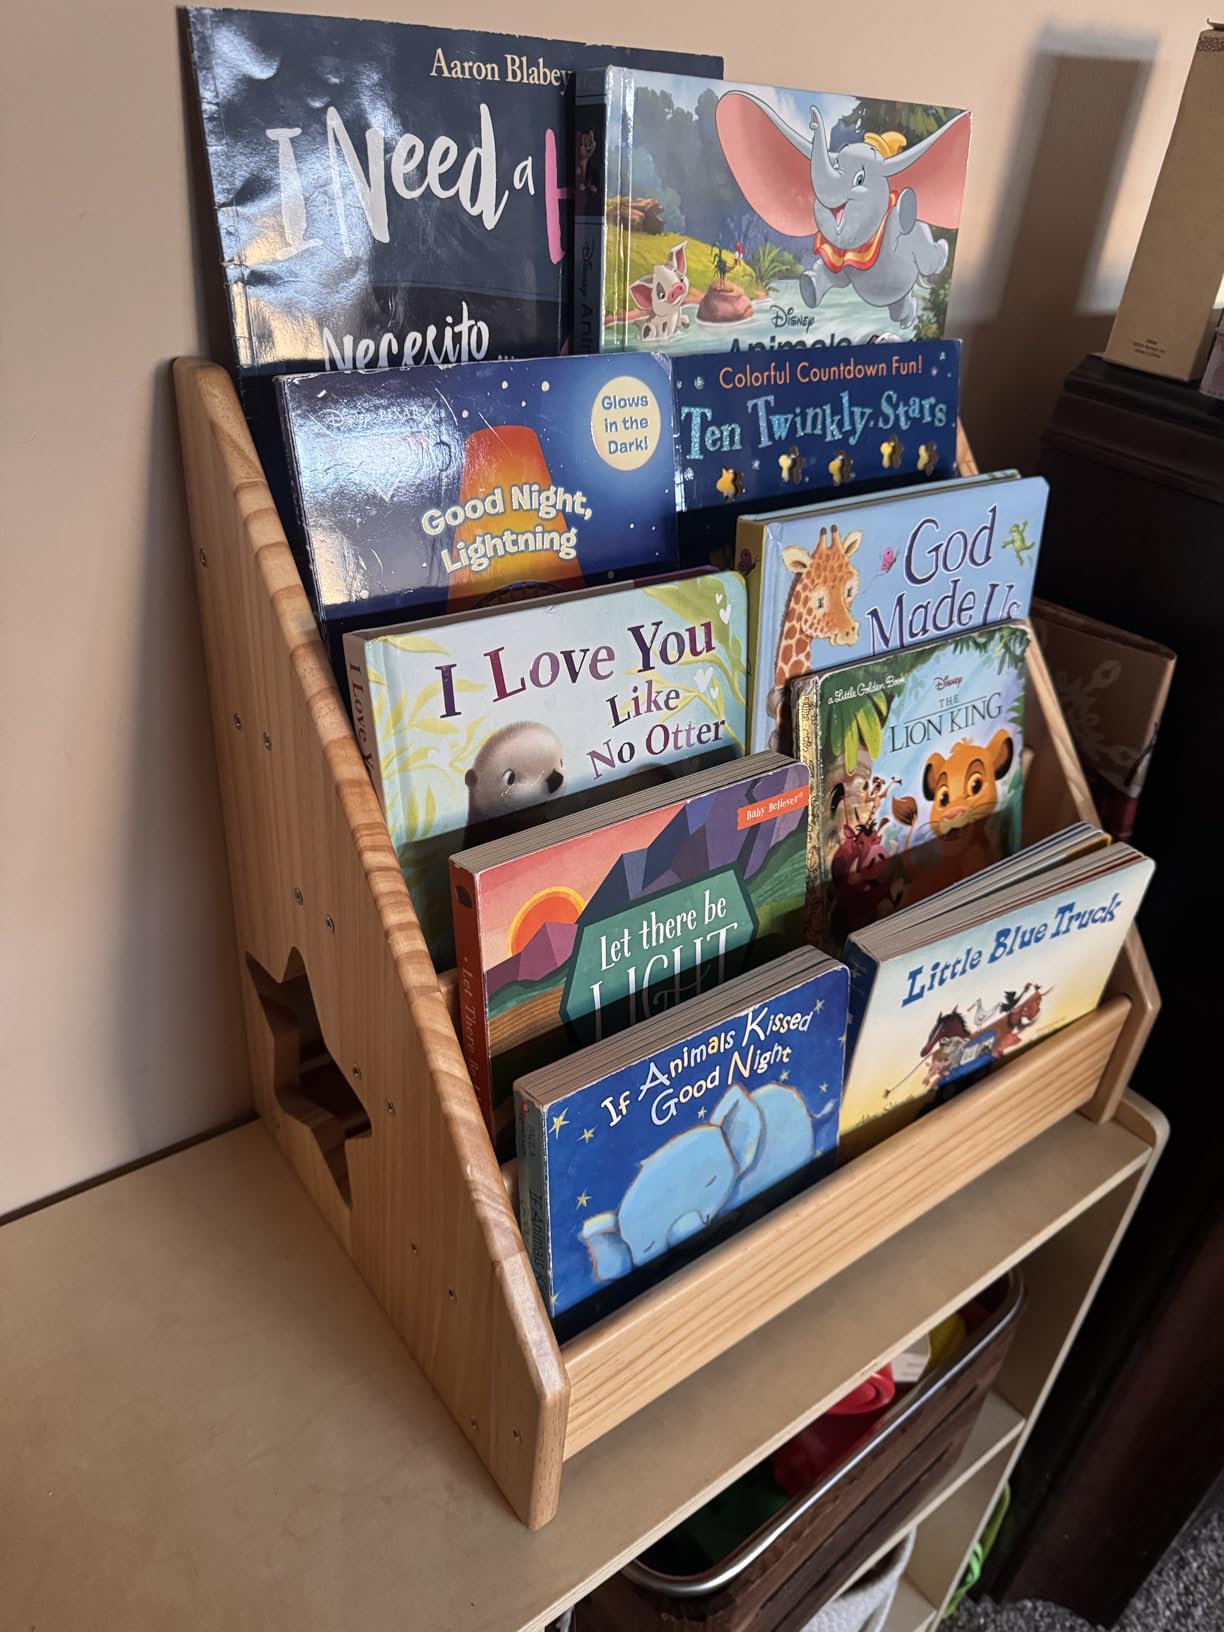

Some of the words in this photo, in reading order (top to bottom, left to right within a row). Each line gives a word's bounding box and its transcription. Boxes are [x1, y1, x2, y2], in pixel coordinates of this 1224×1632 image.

[429, 47, 500, 82] Aaron
[506, 54, 573, 95] Blabey
[265, 127, 323, 259] I
[326, 103, 509, 258] Need
[513, 156, 535, 196] a
[322, 301, 490, 371] Necesito
[769, 304, 815, 333] Disney
[719, 361, 790, 389] Colorful
[797, 358, 887, 383] Countdown
[892, 355, 923, 375] Fun!
[601, 394, 649, 411] Glows
[604, 418, 618, 433] in
[622, 416, 649, 431] the
[680, 406, 743, 460] Ten
[746, 390, 873, 448] Twinkly
[878, 390, 948, 431] Stars
[608, 436, 649, 455] Dark!
[421, 488, 504, 537] Good
[511, 483, 593, 521] Night,
[440, 525, 578, 574] Lightning
[904, 503, 998, 586] God
[866, 578, 977, 656] Made
[435, 663, 462, 718] I
[483, 644, 615, 703] Love
[628, 620, 716, 673] You
[834, 686, 857, 703] Little
[857, 681, 885, 697] Golden
[885, 674, 906, 689] Book
[934, 675, 963, 691] Disney
[352, 680, 367, 743] Love
[606, 680, 680, 728] Like
[889, 714, 942, 753] LION
[950, 692, 1002, 733] KING
[938, 694, 960, 708] THE
[586, 739, 635, 780] No
[645, 719, 727, 756] Otter
[747, 806, 766, 820] Baby
[600, 928, 632, 971] Let
[639, 910, 697, 950] there
[704, 889, 727, 925] be
[901, 947, 983, 1008] Little
[987, 922, 1049, 965] Blue
[1051, 892, 1122, 939] Truck
[601, 1090, 631, 1127] If
[637, 1030, 736, 1101] Animals
[742, 1007, 813, 1048] Kissed
[651, 1066, 720, 1126] Good
[727, 1043, 792, 1085] Night
